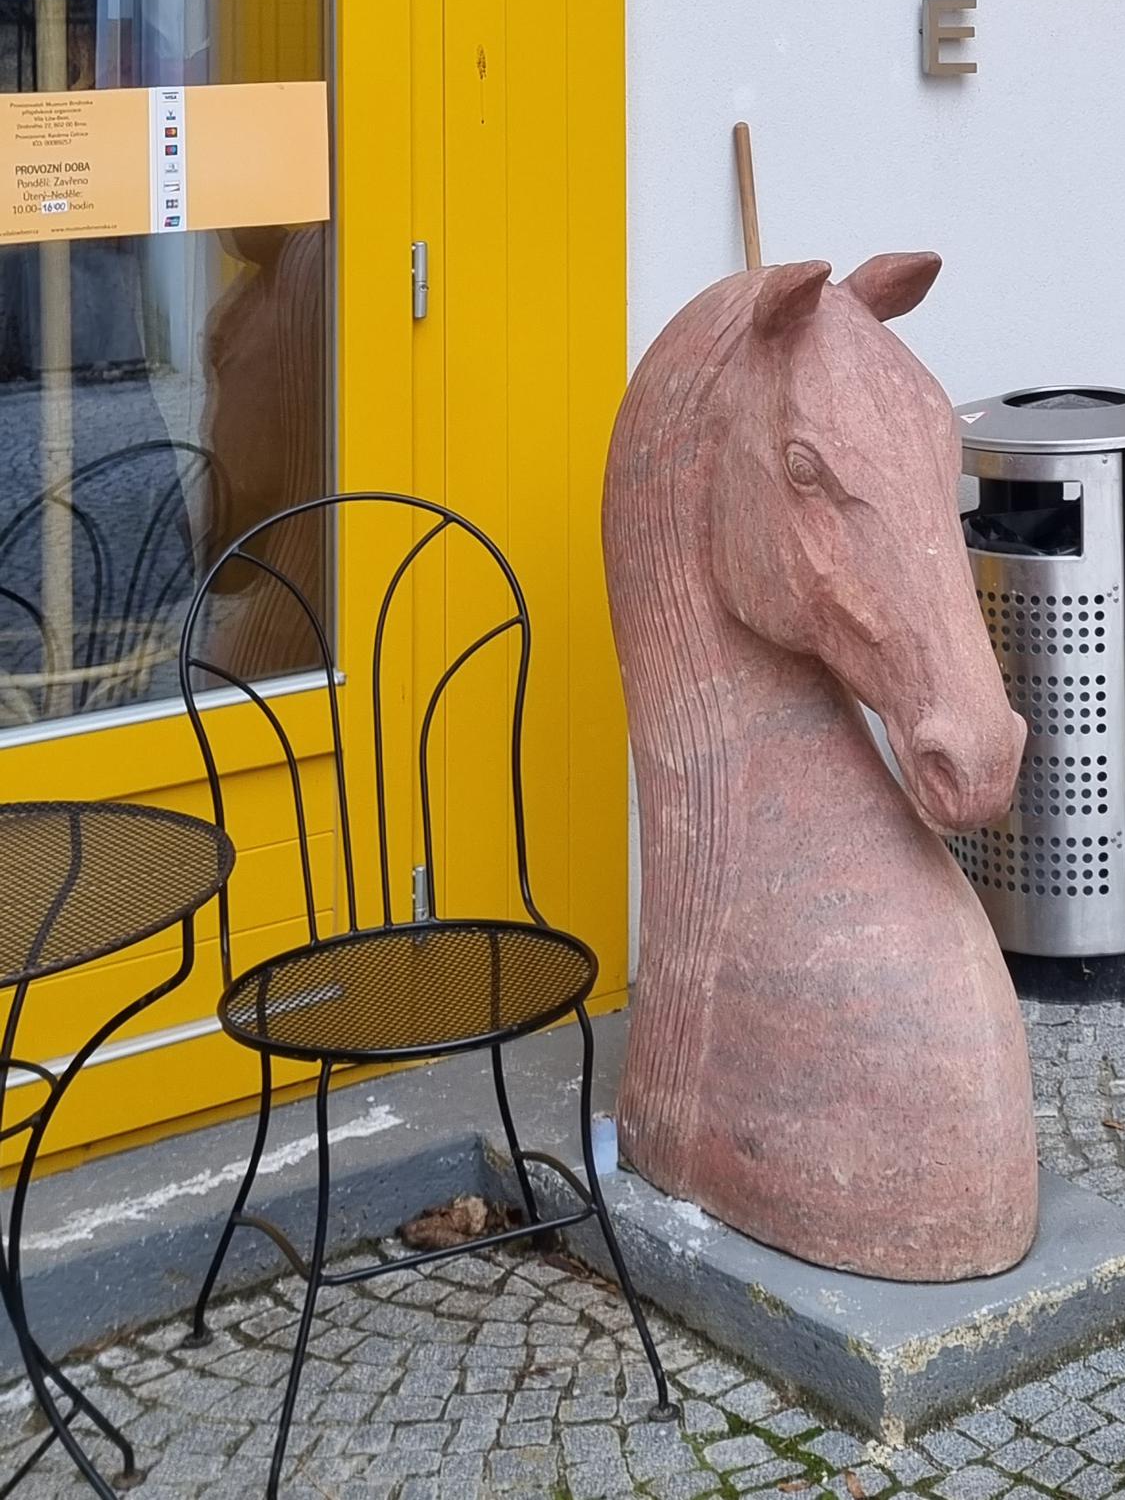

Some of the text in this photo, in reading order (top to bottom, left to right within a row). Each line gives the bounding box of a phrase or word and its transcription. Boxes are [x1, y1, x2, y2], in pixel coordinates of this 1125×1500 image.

[15, 161, 91, 175] PROVOZNÍ DOBA
[17, 176, 89, 189] Pondělí: Zavřeno
[69, 202, 94, 211] hodin
